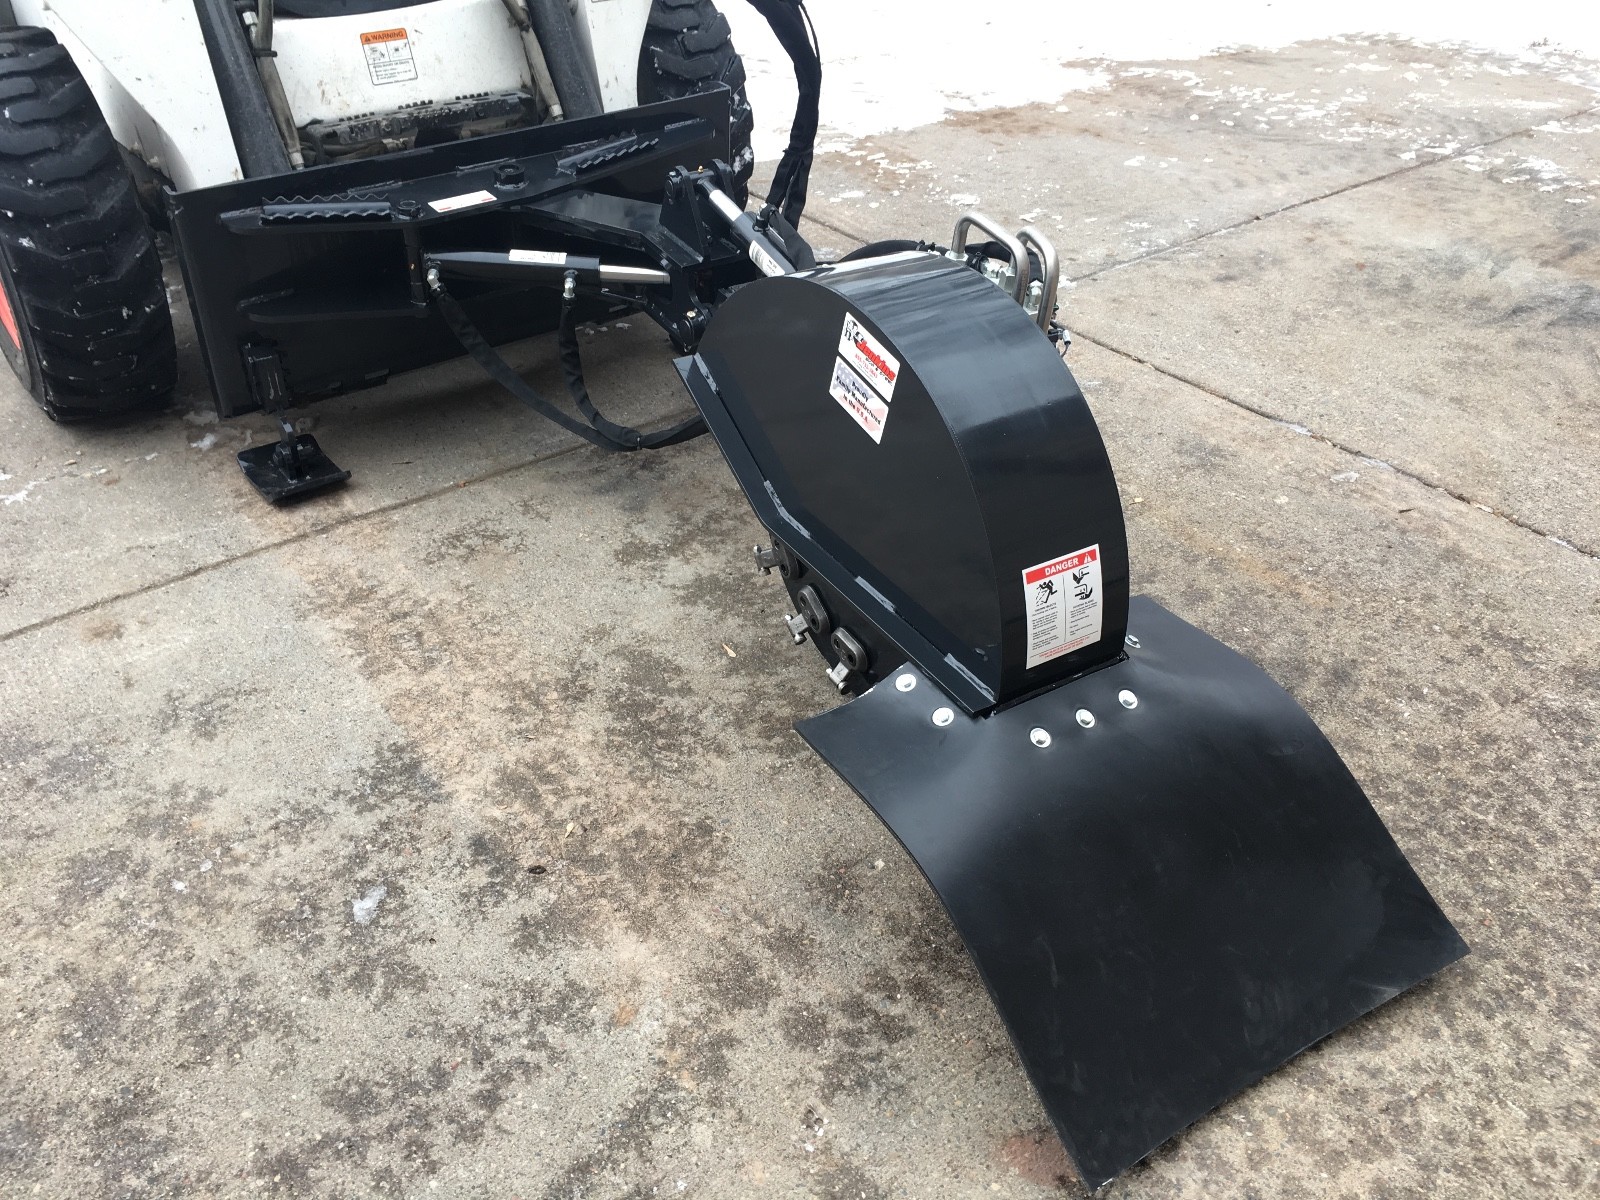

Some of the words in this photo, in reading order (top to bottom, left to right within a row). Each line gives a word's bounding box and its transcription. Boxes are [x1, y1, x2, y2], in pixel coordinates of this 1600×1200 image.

[371, 31, 404, 40] WARNING
[856, 340, 896, 381] Jenkins
[836, 375, 850, 395] Family
[851, 391, 881, 426] Manufactured
[852, 381, 869, 402] Proudly
[1045, 558, 1079, 576] DANGER
